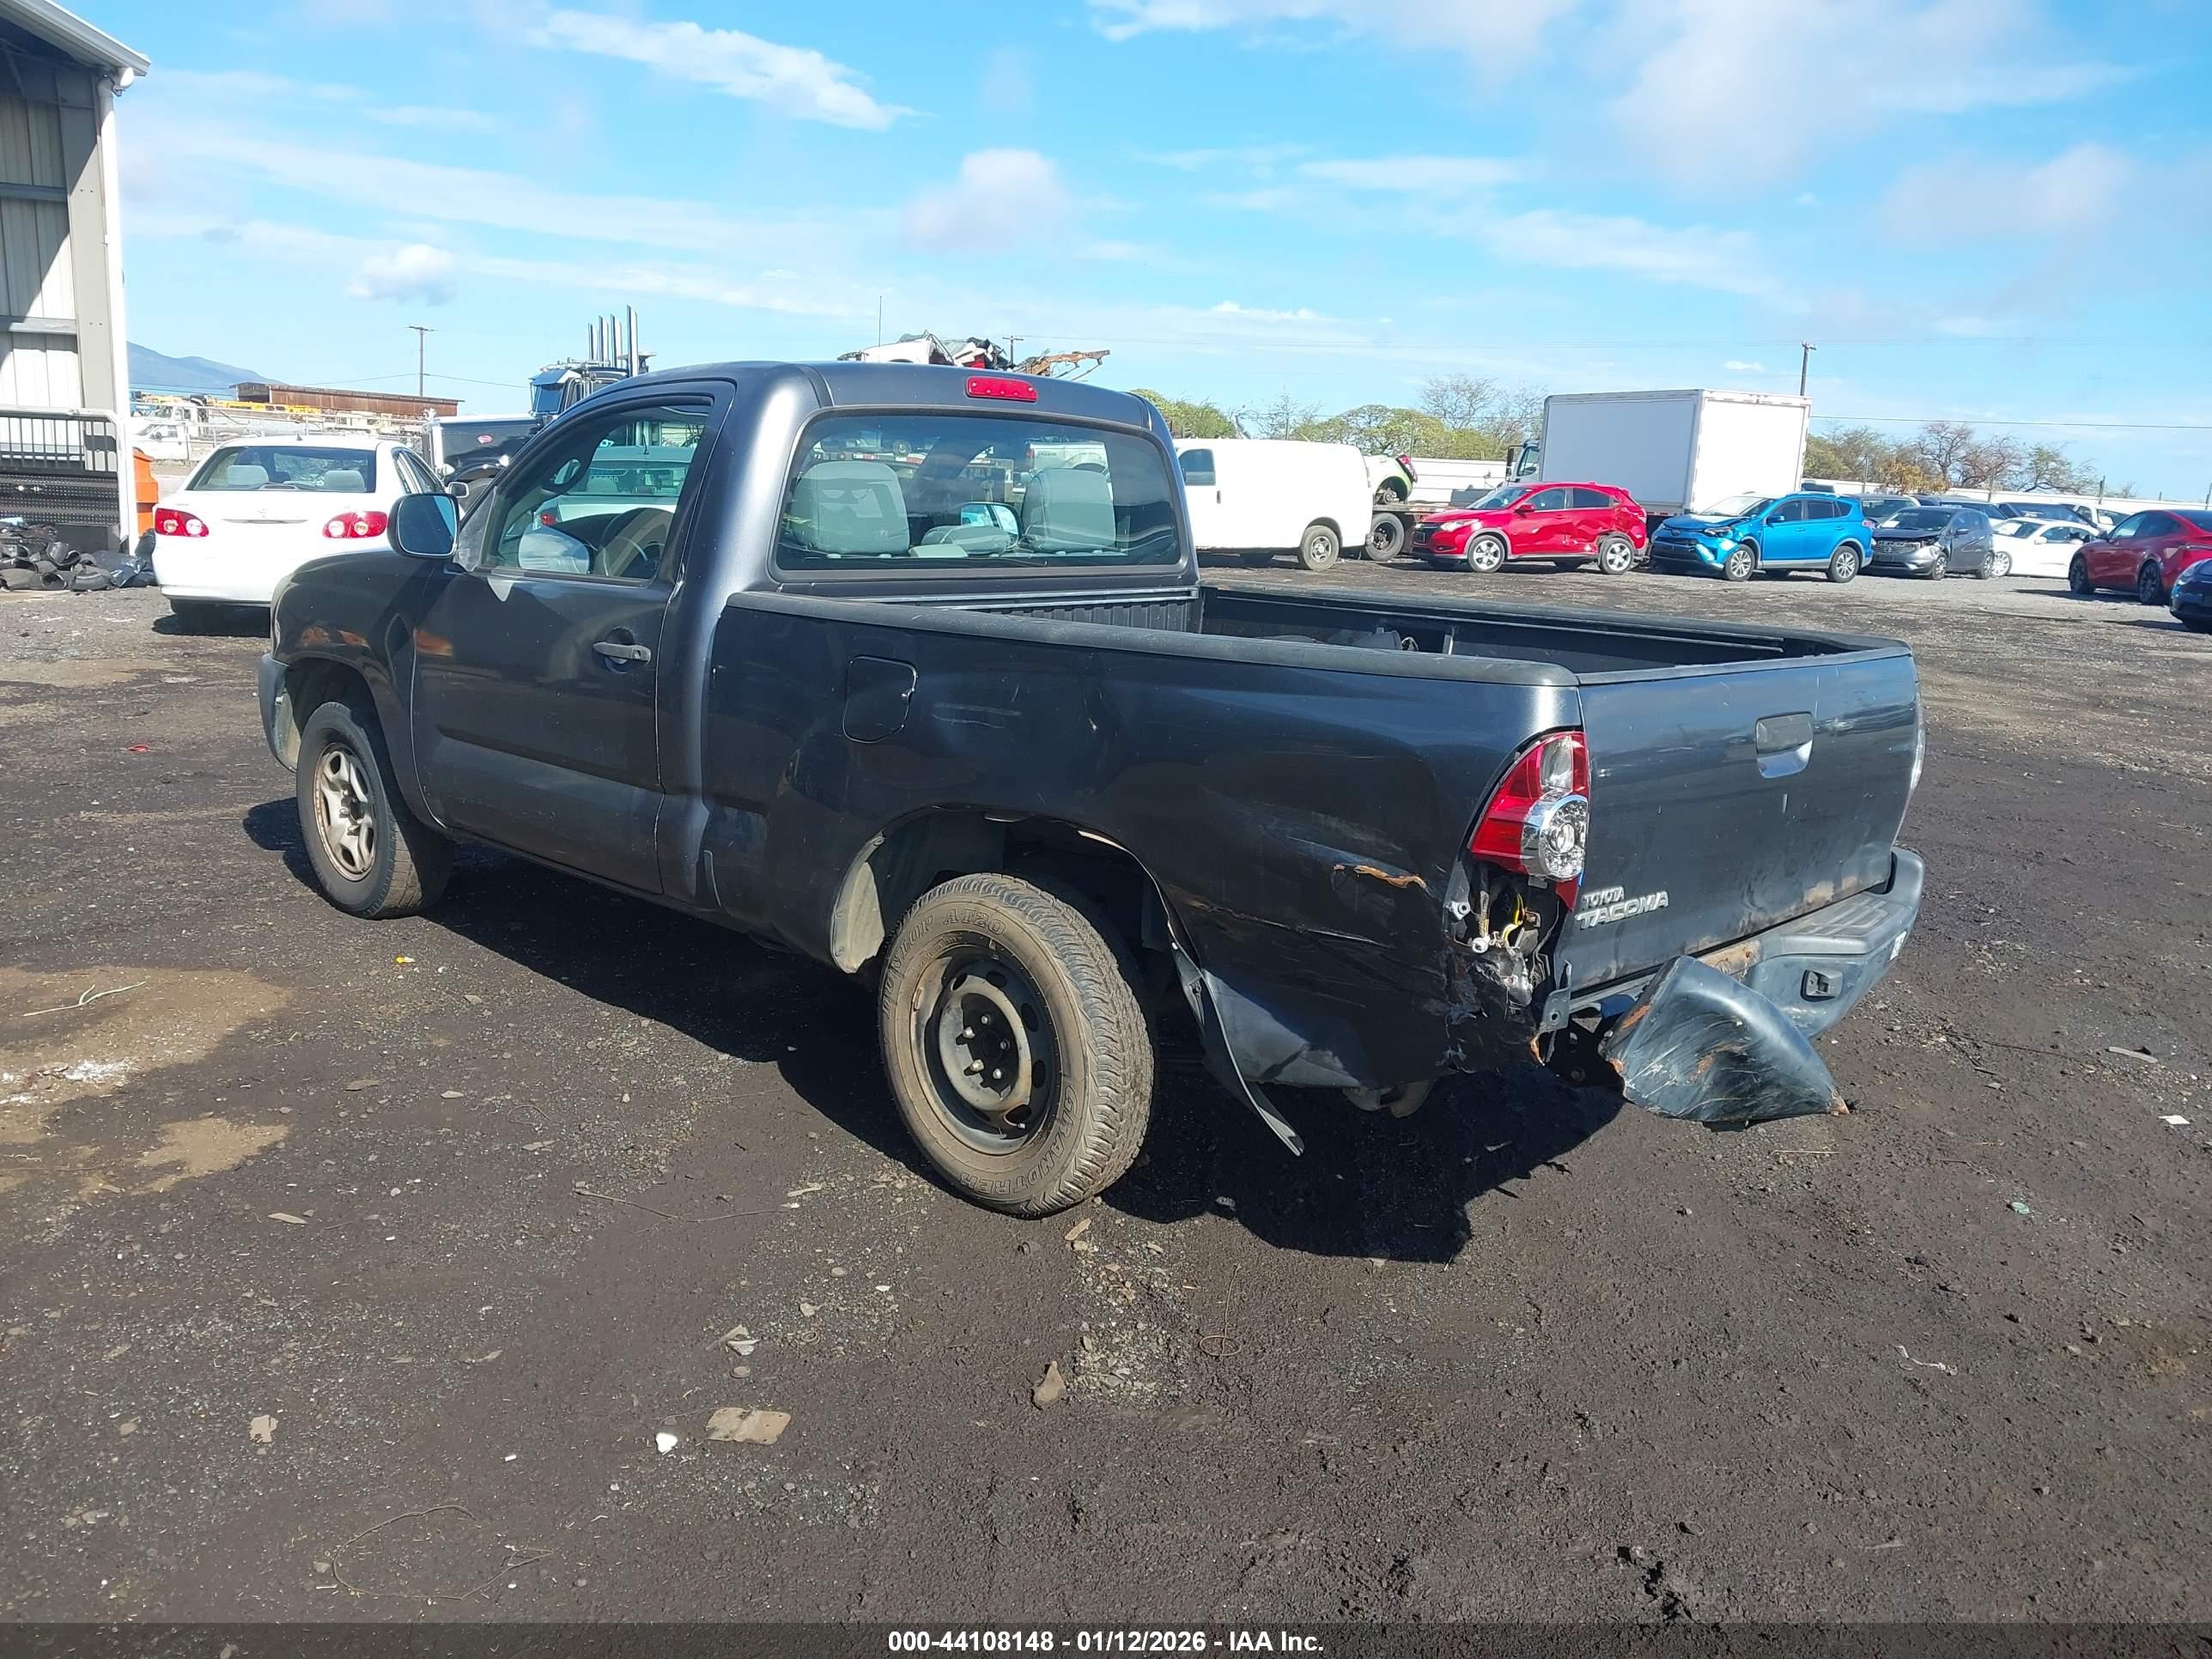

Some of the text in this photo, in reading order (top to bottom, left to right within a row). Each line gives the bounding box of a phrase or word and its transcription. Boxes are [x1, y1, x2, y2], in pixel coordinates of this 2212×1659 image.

[1575, 890, 1669, 931] TACOMA
[1582, 885, 1625, 908] TOYOTA
[943, 908, 1006, 936] AT20
[960, 1085, 1079, 1195] GRANDTREK
